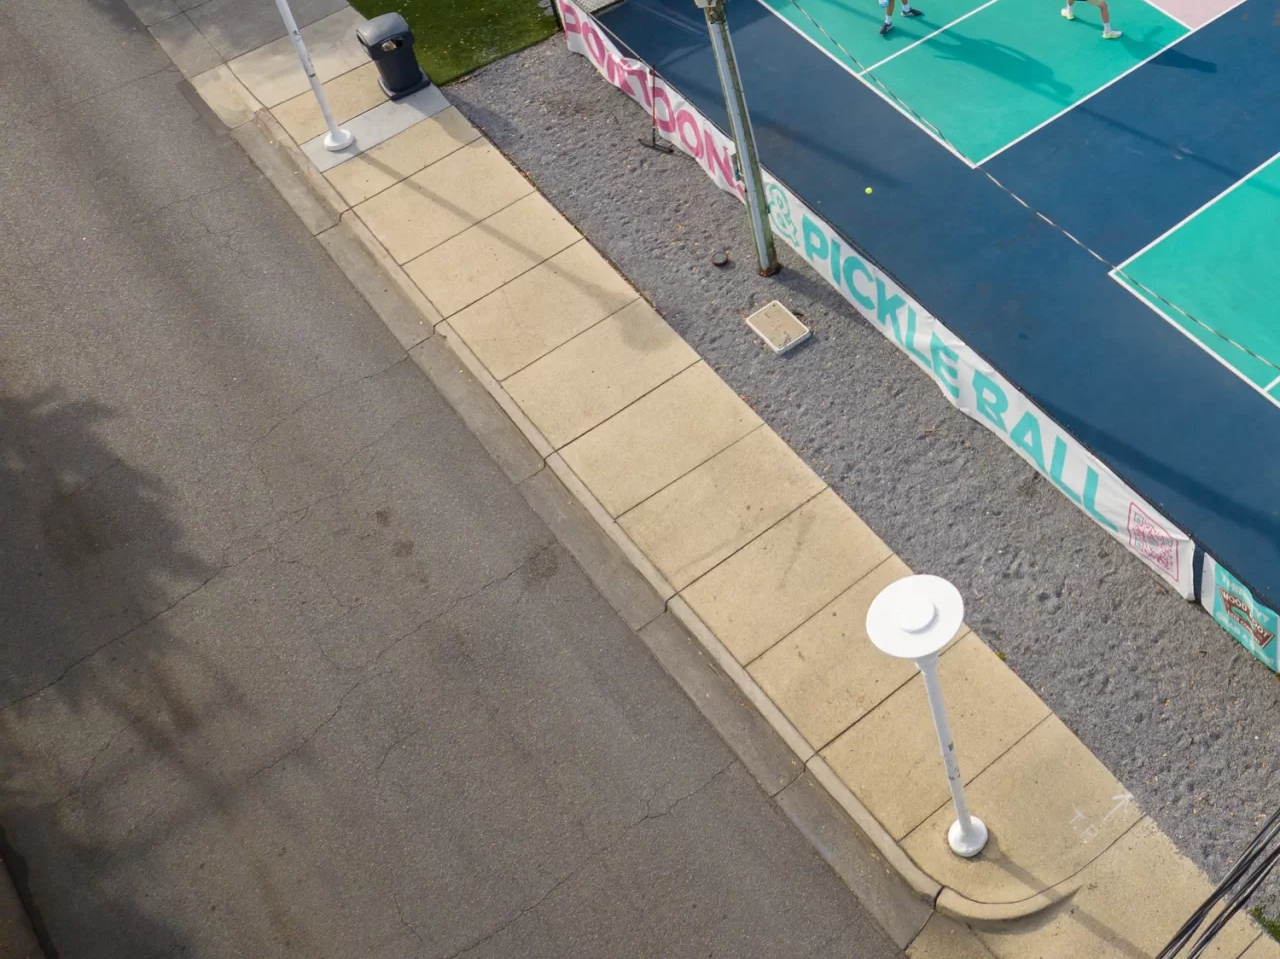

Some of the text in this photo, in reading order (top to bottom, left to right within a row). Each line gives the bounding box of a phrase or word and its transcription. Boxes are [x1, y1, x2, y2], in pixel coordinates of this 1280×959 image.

[766, 183, 800, 246] &
[801, 214, 960, 399] PICKLE
[1222, 591, 1248, 612] WOOD
